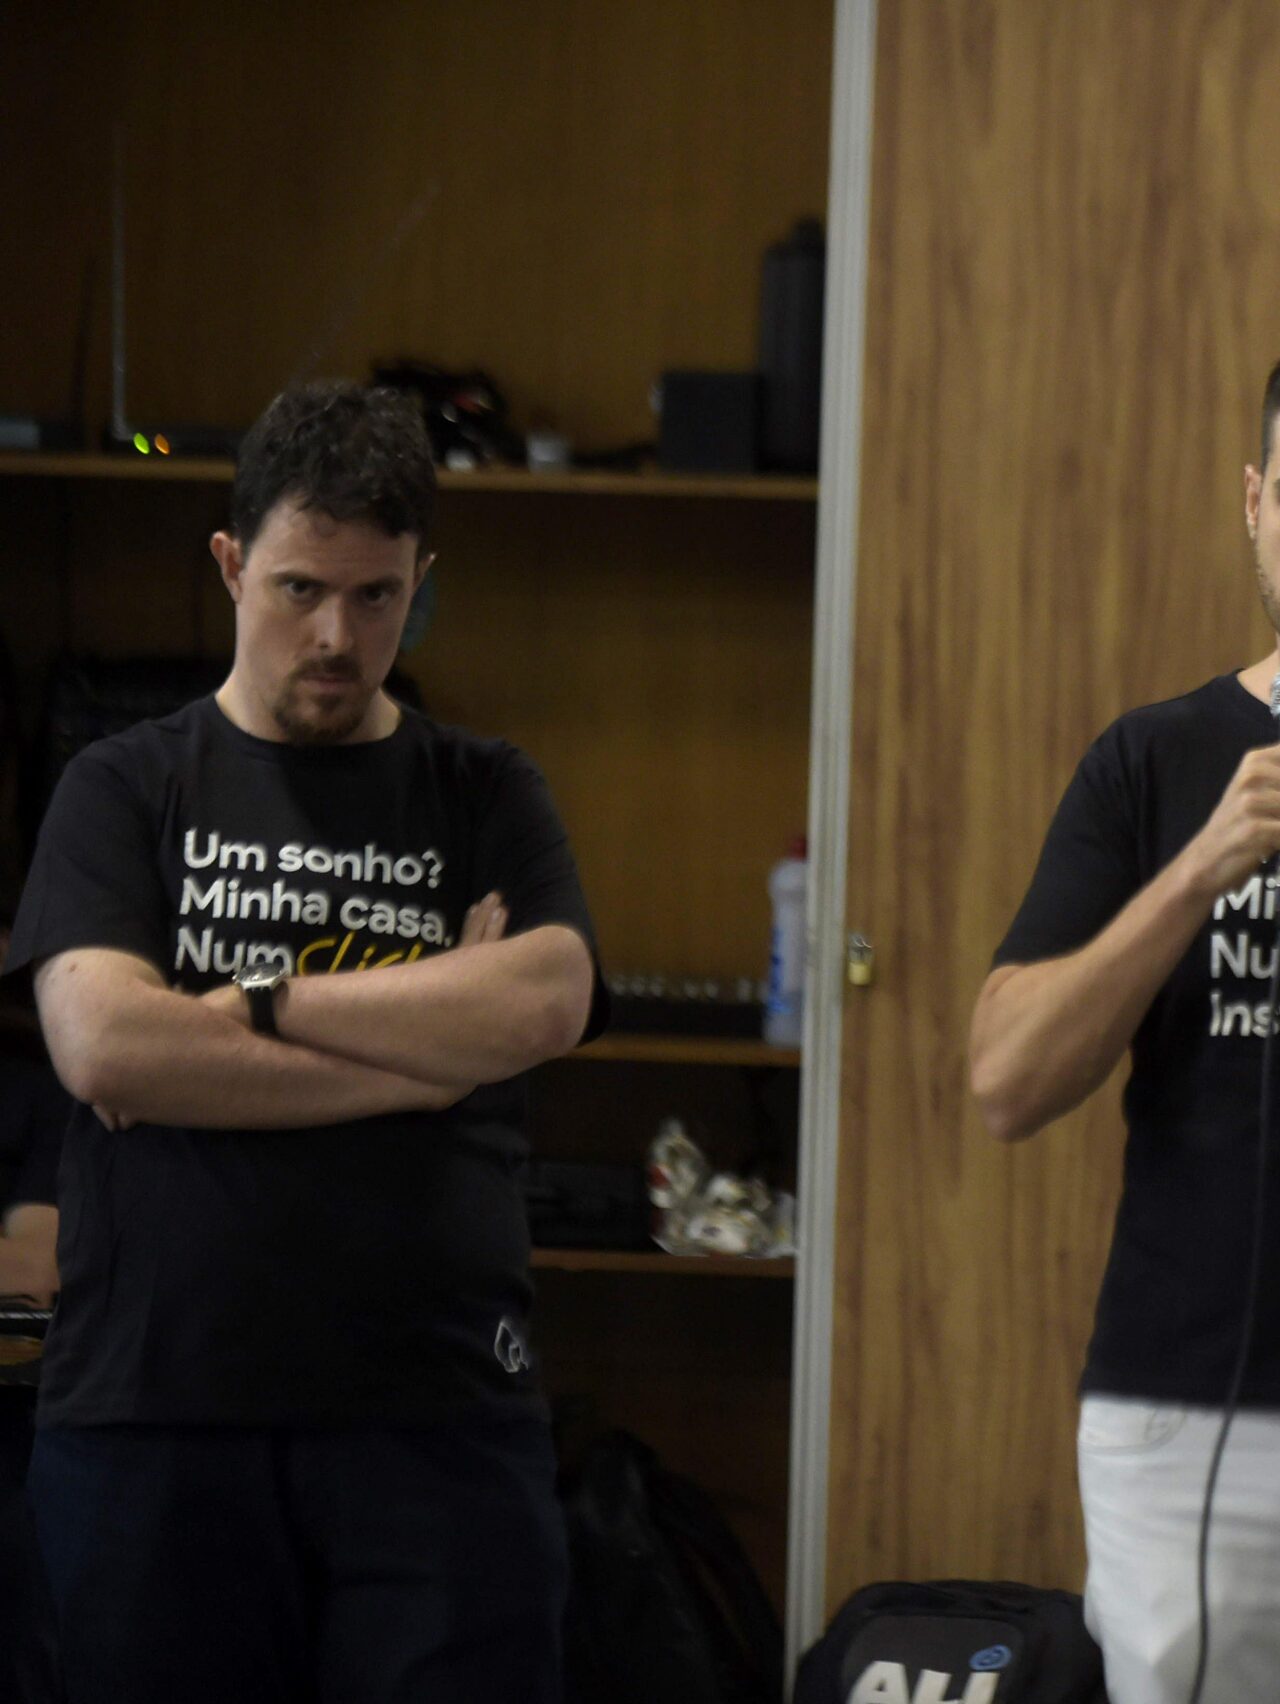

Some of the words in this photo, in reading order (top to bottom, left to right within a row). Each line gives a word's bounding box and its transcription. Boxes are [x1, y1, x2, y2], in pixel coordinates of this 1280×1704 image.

[183, 826, 266, 872] Um
[277, 842, 444, 889] sonho?
[179, 877, 330, 926] Minha
[339, 896, 453, 948] casa.
